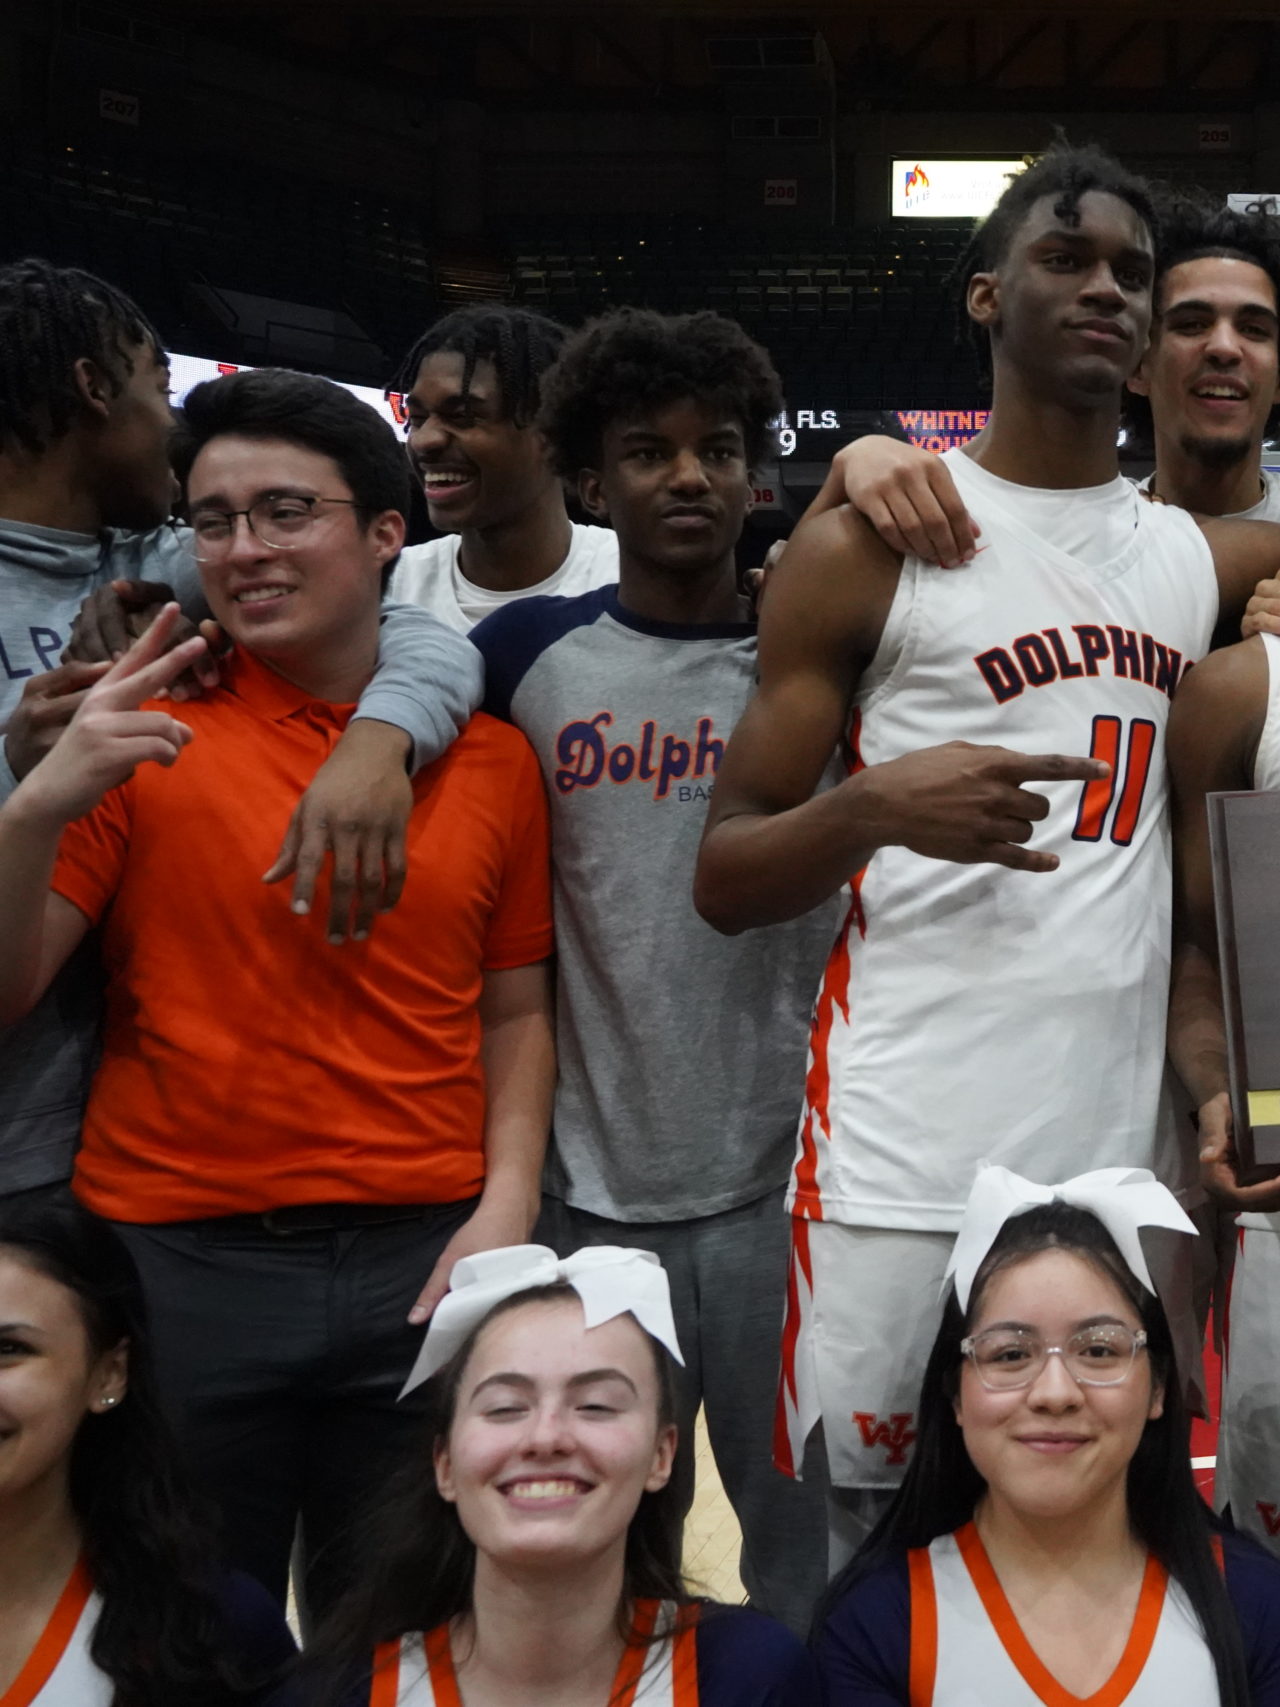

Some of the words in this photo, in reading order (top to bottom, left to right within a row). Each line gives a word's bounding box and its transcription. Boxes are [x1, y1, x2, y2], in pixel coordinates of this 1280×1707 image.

[897, 411, 992, 429] WHITNE
[973, 624, 1196, 705] DOLPHIN
[1071, 714, 1156, 847] 11
